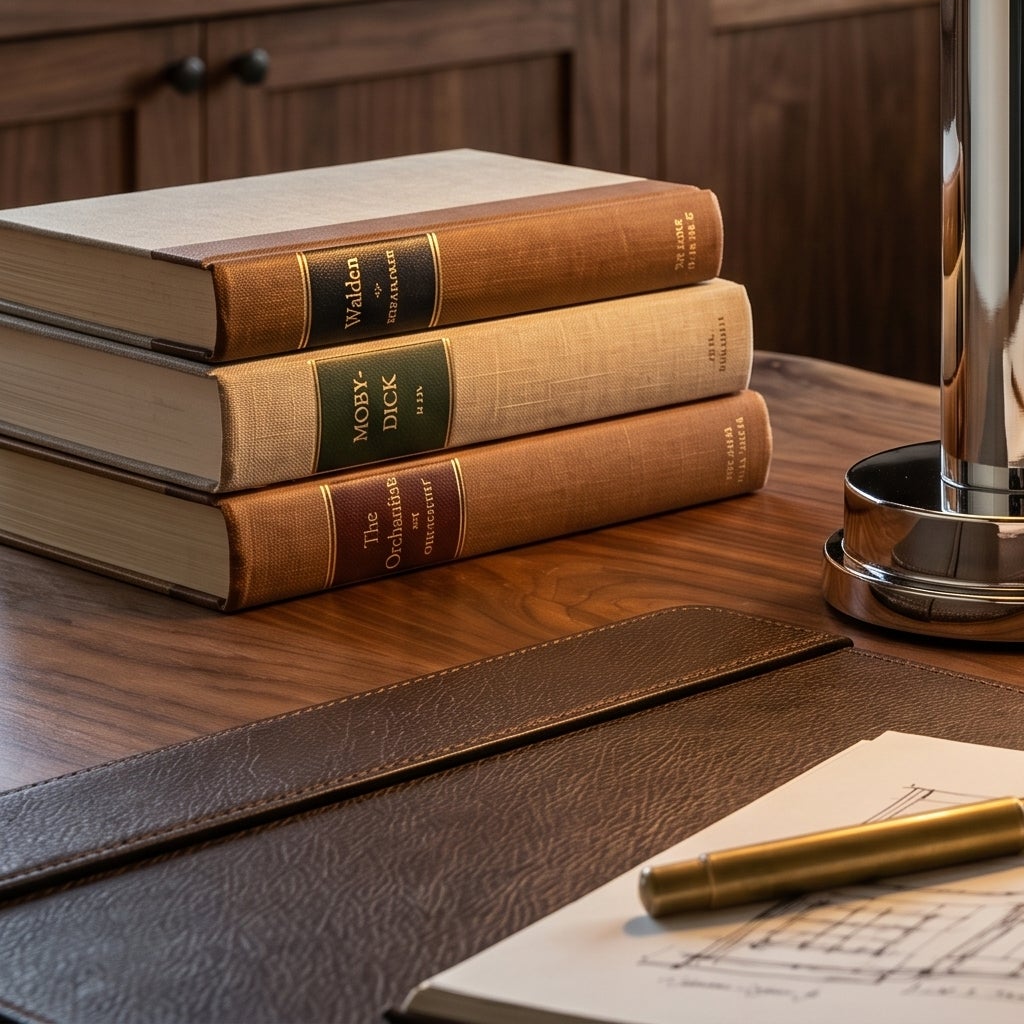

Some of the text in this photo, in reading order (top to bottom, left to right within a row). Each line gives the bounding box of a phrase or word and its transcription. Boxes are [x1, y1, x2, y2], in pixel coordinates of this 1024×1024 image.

[345, 257, 363, 330] Walden
[353, 370, 369, 443] MOBY-
[382, 374, 398, 431] DICK
[363, 512, 379, 549] The
